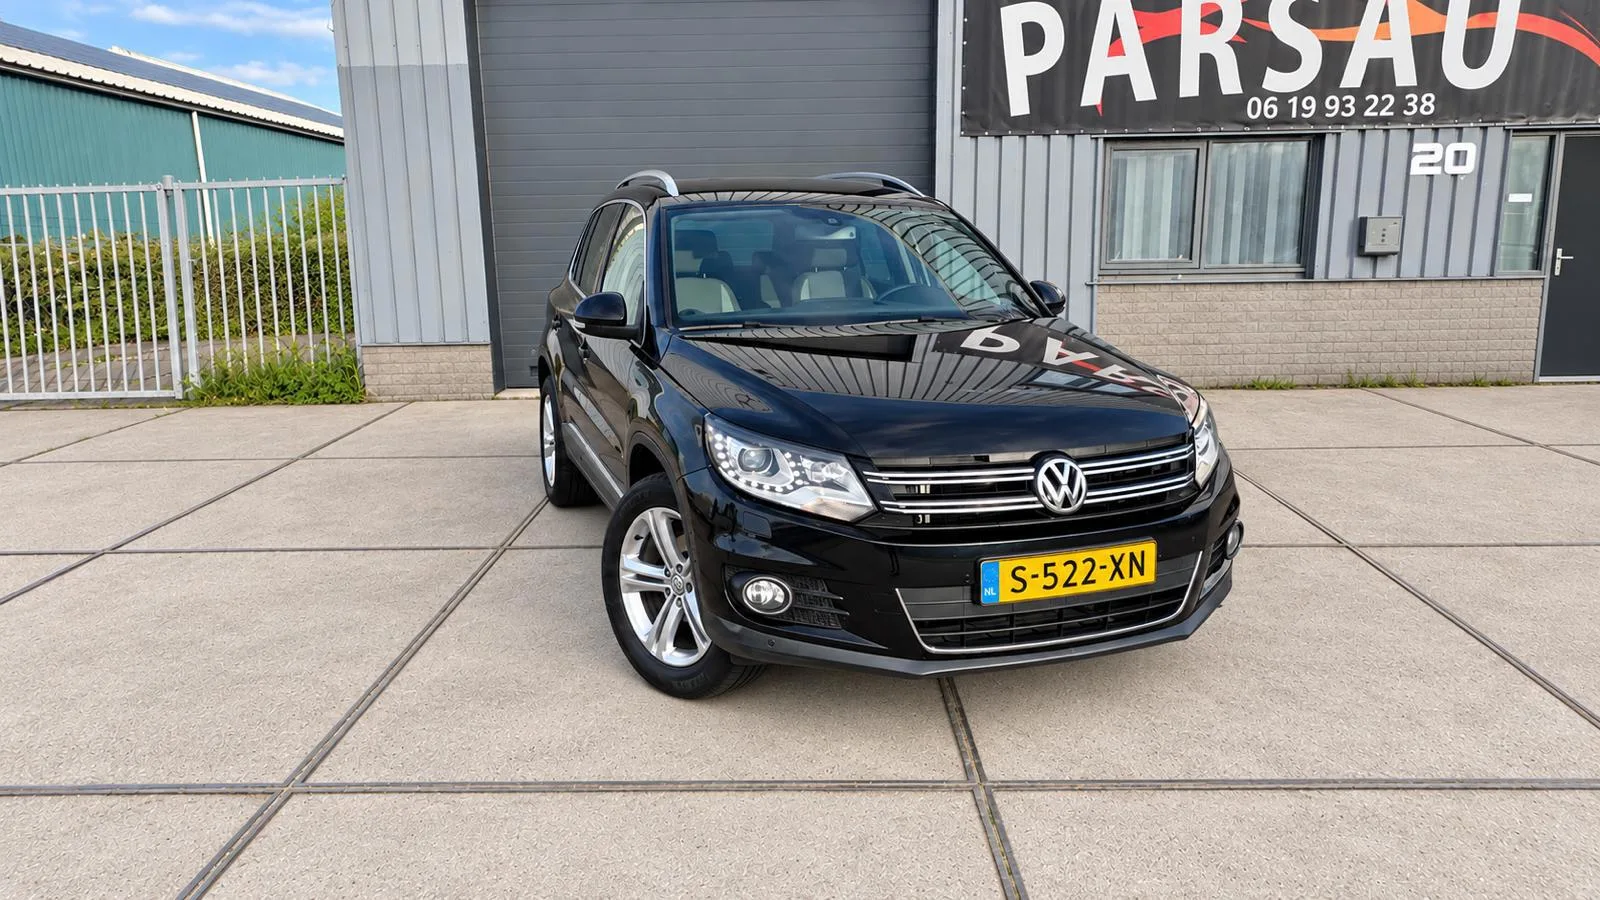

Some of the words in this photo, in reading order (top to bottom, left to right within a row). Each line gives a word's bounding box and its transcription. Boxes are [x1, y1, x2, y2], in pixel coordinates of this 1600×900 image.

[1246, 96, 1278, 119] 06
[1287, 95, 1317, 119] 19
[1324, 94, 1356, 118] 93
[1363, 94, 1395, 117] 22
[1402, 92, 1436, 116] 38
[1410, 142, 1477, 175] 20
[1038, 459, 1086, 512] VW
[1010, 550, 1146, 594] S-522-XN
[984, 587, 996, 596] NL
